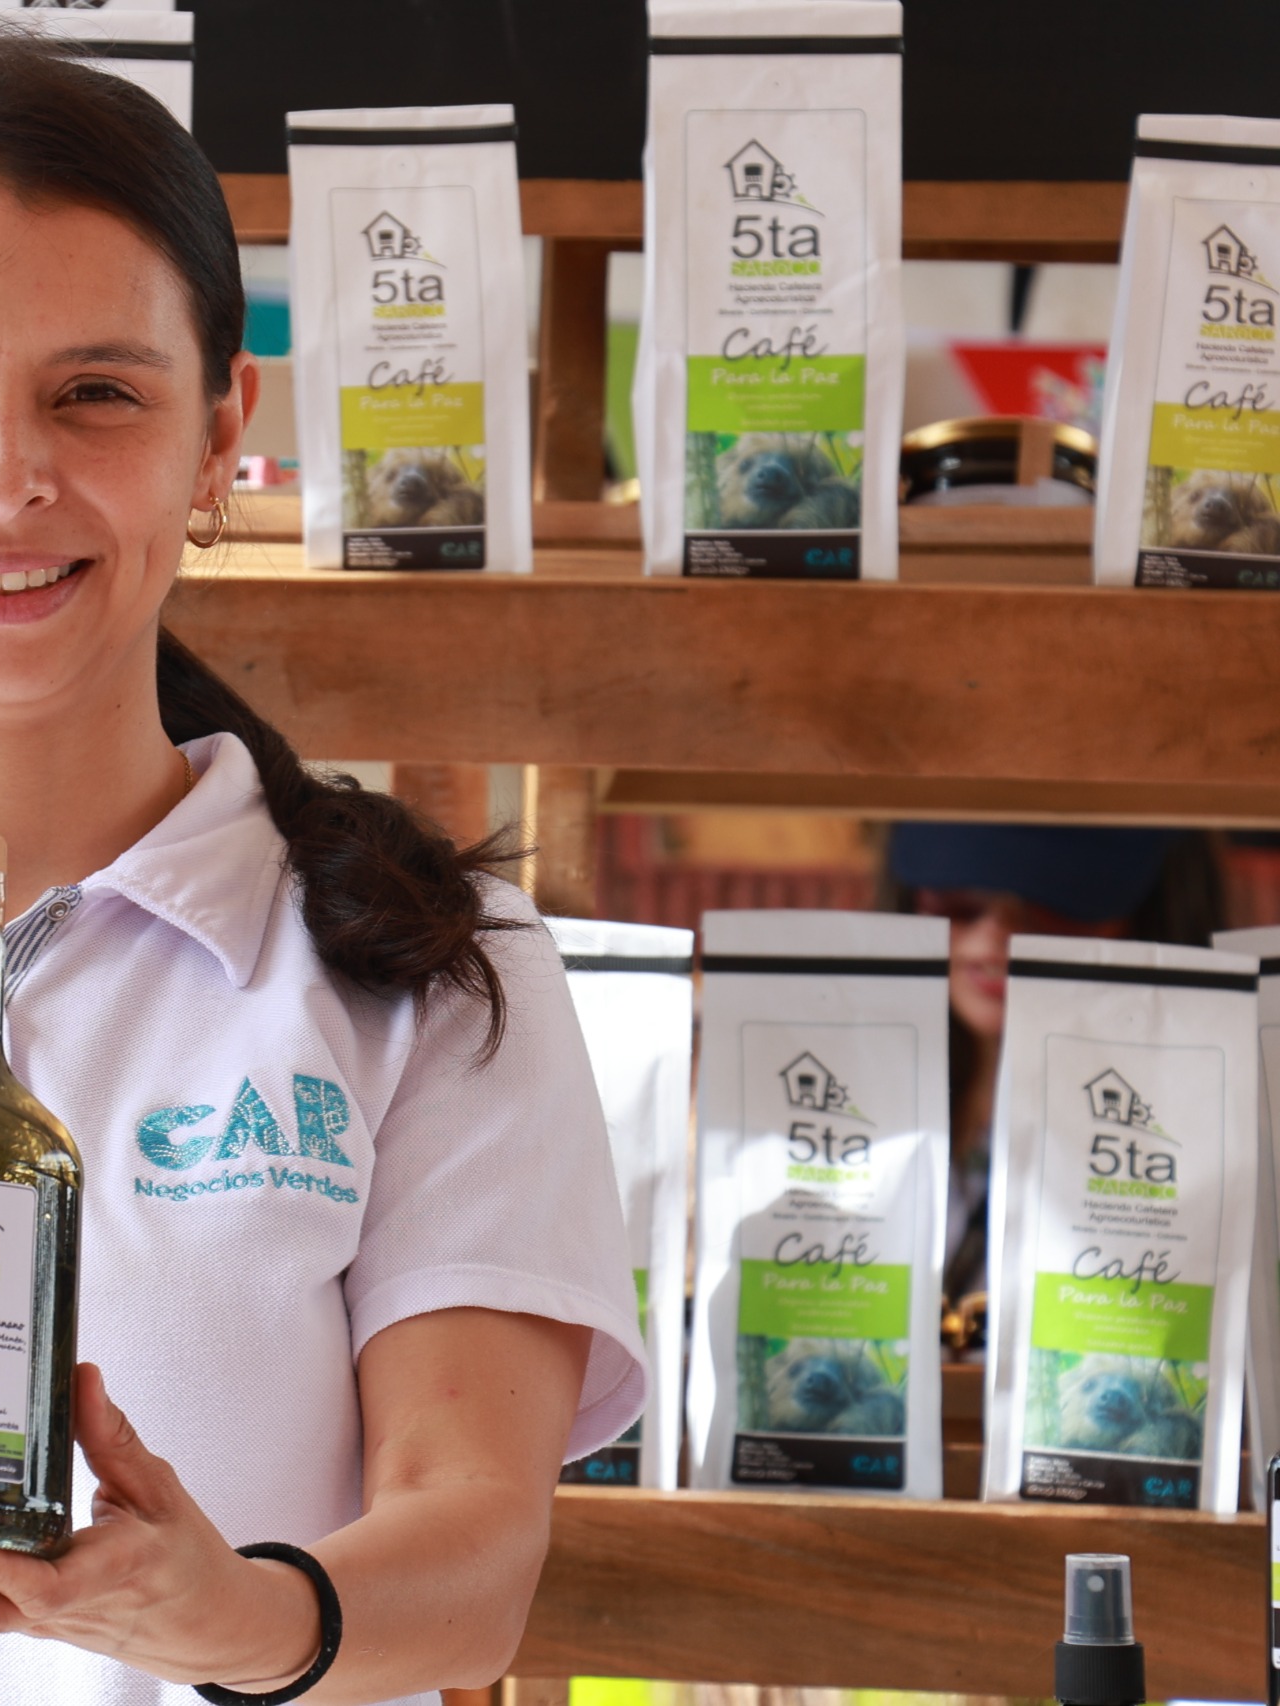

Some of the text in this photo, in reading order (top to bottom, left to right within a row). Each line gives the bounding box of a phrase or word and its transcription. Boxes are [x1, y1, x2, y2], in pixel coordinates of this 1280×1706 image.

[730, 214, 822, 259] 5ta
[371, 268, 445, 304] 5ta
[1201, 283, 1276, 327] 5ta
[722, 323, 830, 372] Café
[368, 355, 456, 397] Café
[710, 367, 841, 386] Para la Paz
[359, 392, 465, 410] Para la Paz
[1184, 379, 1277, 421] Café
[1173, 412, 1216, 429] Para
[1223, 417, 1241, 432] la
[135, 1073, 355, 1172] CAR
[787, 1121, 872, 1166] 5ta
[1088, 1134, 1177, 1183] 5ta
[133, 1165, 361, 1204] Negocios Verdes
[774, 1231, 881, 1278] Café
[1073, 1245, 1182, 1294] Café
[763, 1272, 890, 1294] Para la Paz
[1058, 1284, 1190, 1314] Para la Paz
[585, 1460, 632, 1481] CAR
[1144, 1475, 1193, 1499] CAR
